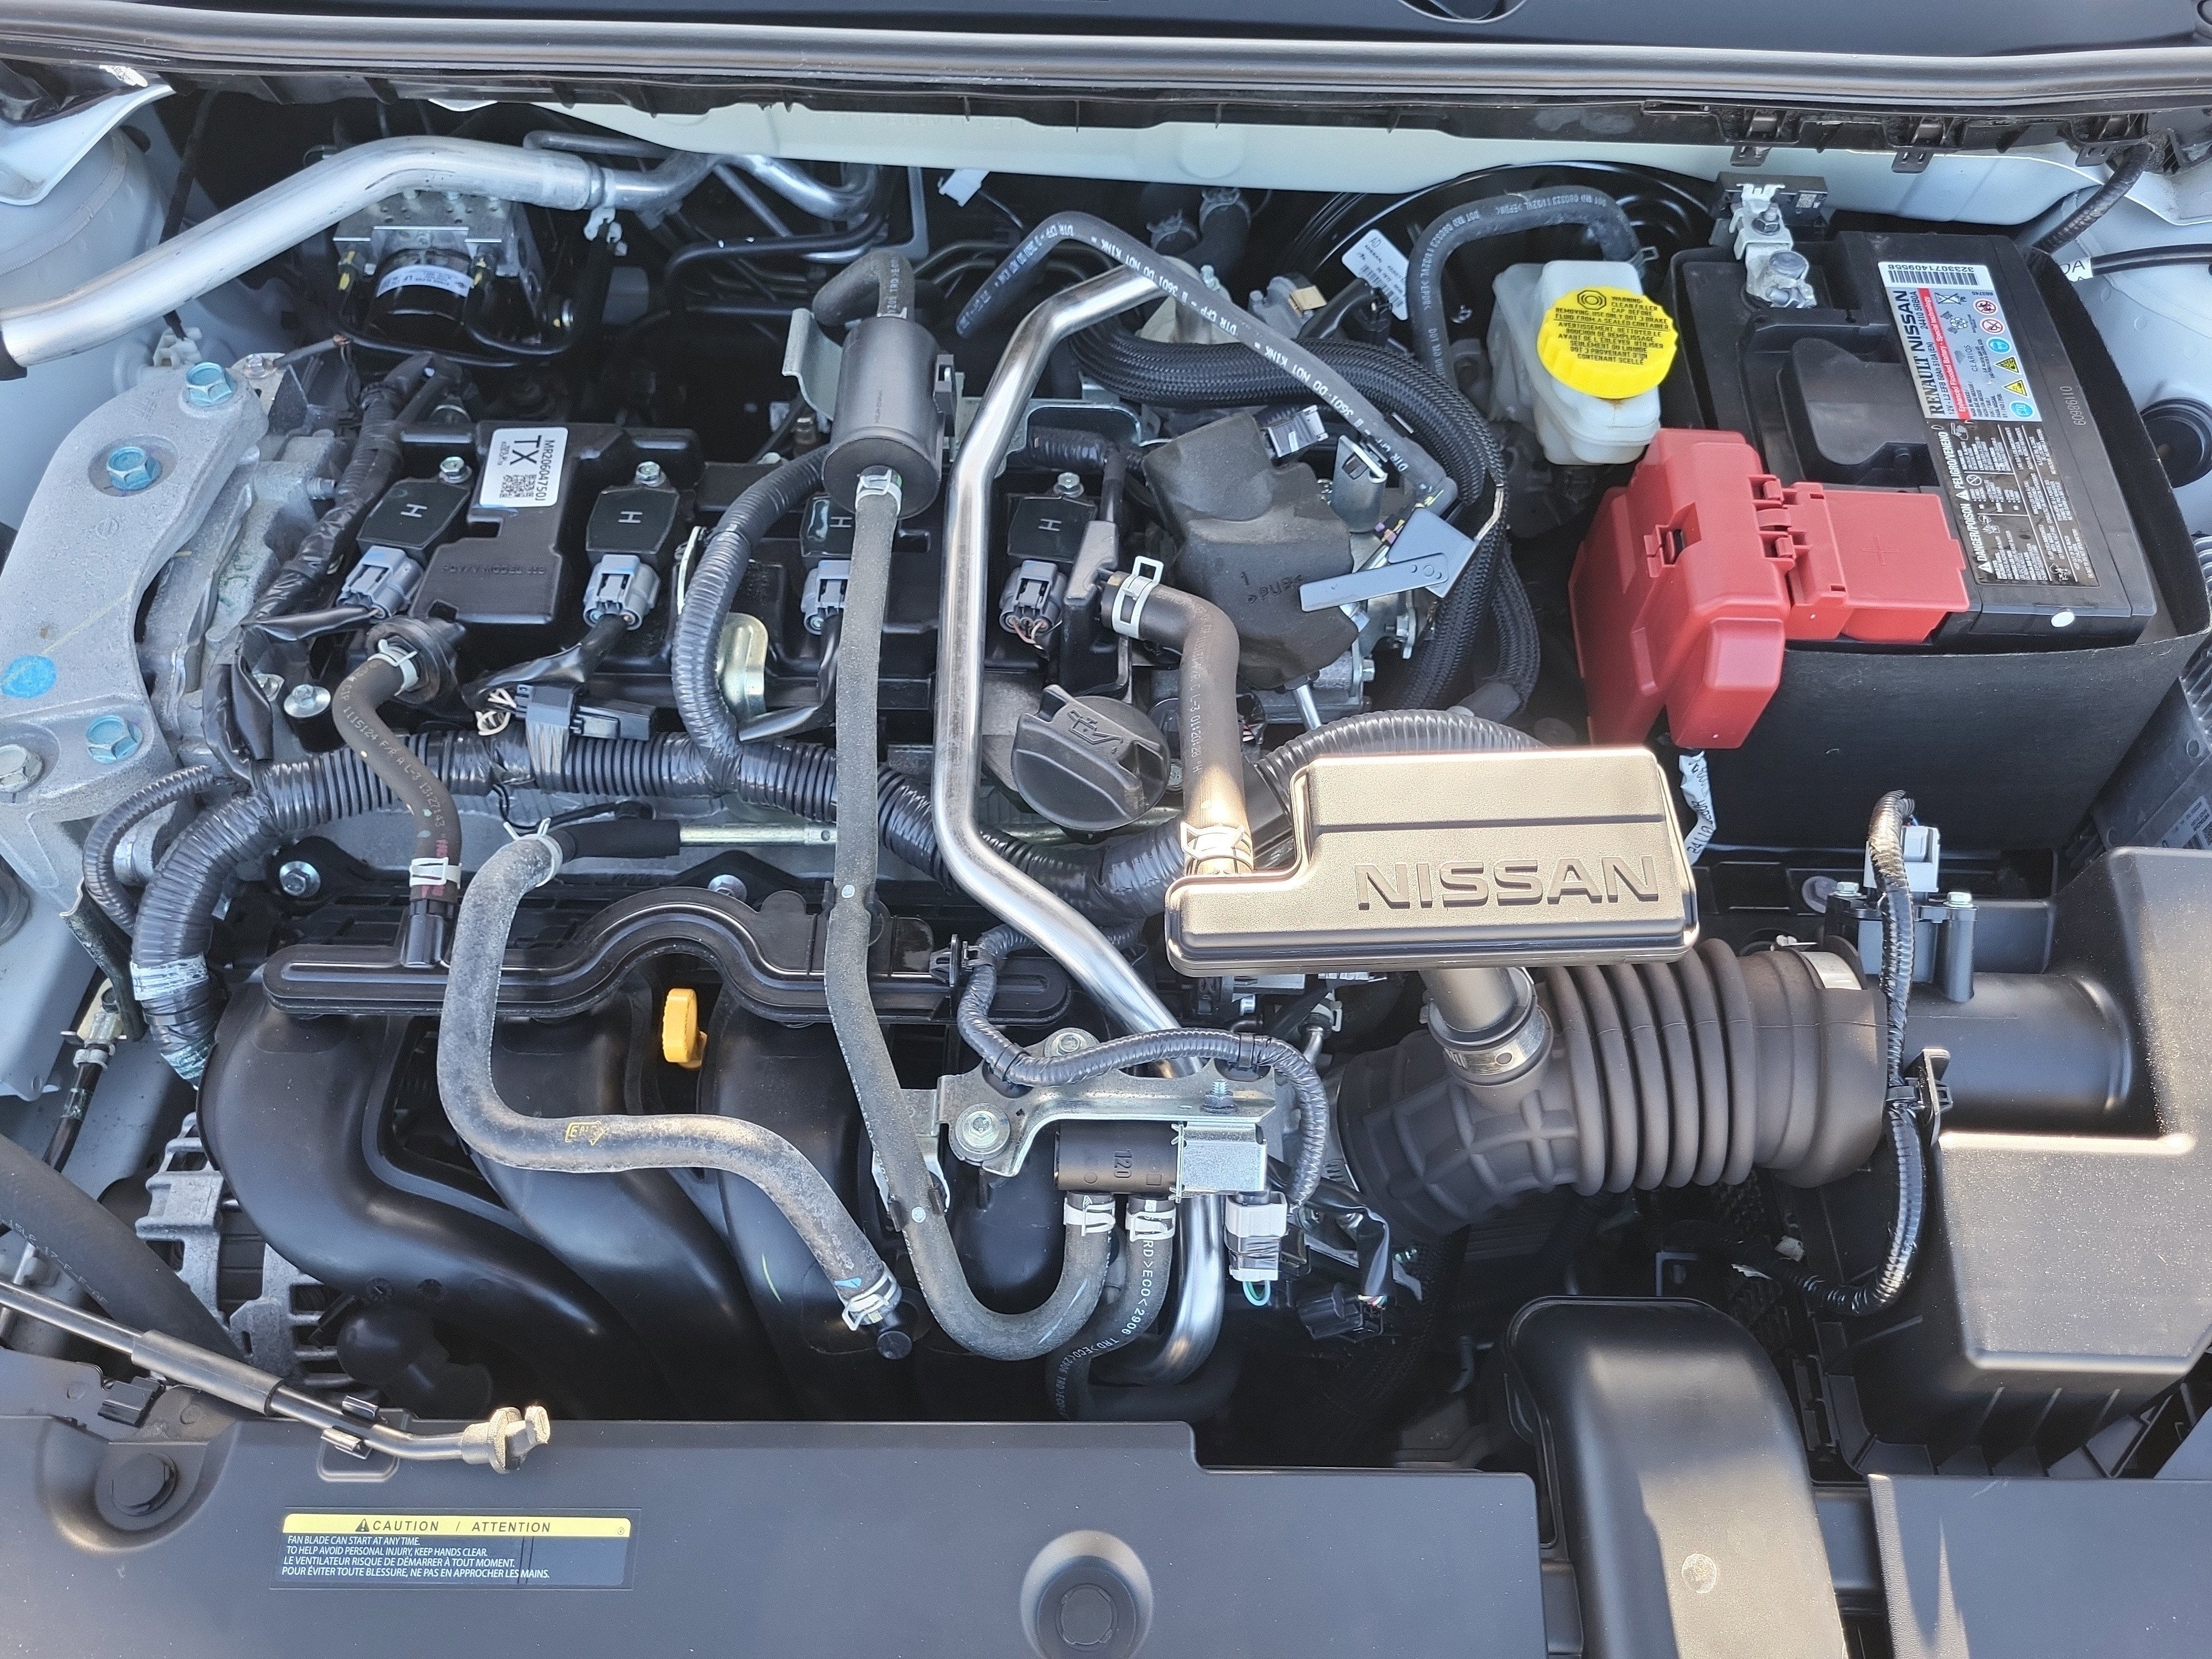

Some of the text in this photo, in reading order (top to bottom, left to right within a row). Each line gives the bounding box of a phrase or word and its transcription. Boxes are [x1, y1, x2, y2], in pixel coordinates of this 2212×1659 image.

[1155, 275, 1180, 295] 3601
[1199, 304, 1219, 322] CFP
[1628, 309, 1652, 317] BEFORE
[1916, 312, 1928, 329] 24410
[1217, 316, 1239, 336] DTR
[1604, 318, 1630, 326] SEALED
[1608, 331, 1654, 342] REMPLISSAGE
[1617, 327, 1651, 336] NETTOYER
[1558, 332, 1580, 341] AVANT
[1634, 340, 1663, 349] UTILISER
[1570, 340, 1609, 349] SEULEMENT
[1622, 345, 1647, 354] LIQUIDE
[1926, 342, 1937, 353] (EN)
[1577, 352, 1615, 363] CONTENANT
[1592, 348, 1630, 358] PROVENANT
[1892, 290, 1945, 415] RENAULT NISSAN
[1922, 296, 1966, 411] Enhanced Flooded Battery Special technology
[1929, 353, 1940, 366] 510A
[1963, 345, 1979, 371] CLARIOS
[1934, 367, 1945, 380] 60Ah
[1938, 382, 1948, 392] EFB
[1262, 344, 1410, 473] DTR 3601 DO NOT KINK
[1945, 404, 1956, 414] 12V
[2060, 384, 2086, 426] 60986110
[509, 435, 542, 465] TX
[1936, 431, 1966, 489] PELIGRO/VENENO
[1959, 503, 1989, 561] DANGER/POISON
[1190, 714, 1201, 758] 01:20:28
[1355, 855, 1660, 911] NISSAN
[1114, 1149, 1133, 1179] 120
[1119, 1306, 1146, 1337] 2906
[372, 1520, 440, 1531] CAUTION
[471, 1521, 552, 1532] ATTENTION
[287, 1535, 421, 1546] FAN BLADE CAN START AT ANY TIME.
[286, 1546, 488, 1557] TO HELP AVOID PERSONAL INJURY, KEEP HANDS CLEAR.
[284, 1556, 515, 1567] LE VENTILATEUR RISQUE DE DÉMARRER À TOUT MOMENT.
[281, 1565, 550, 1578] POUR ÉVITER TOUTE BLESSURE, NE PAS EN APPROCHER LES MAINS.
